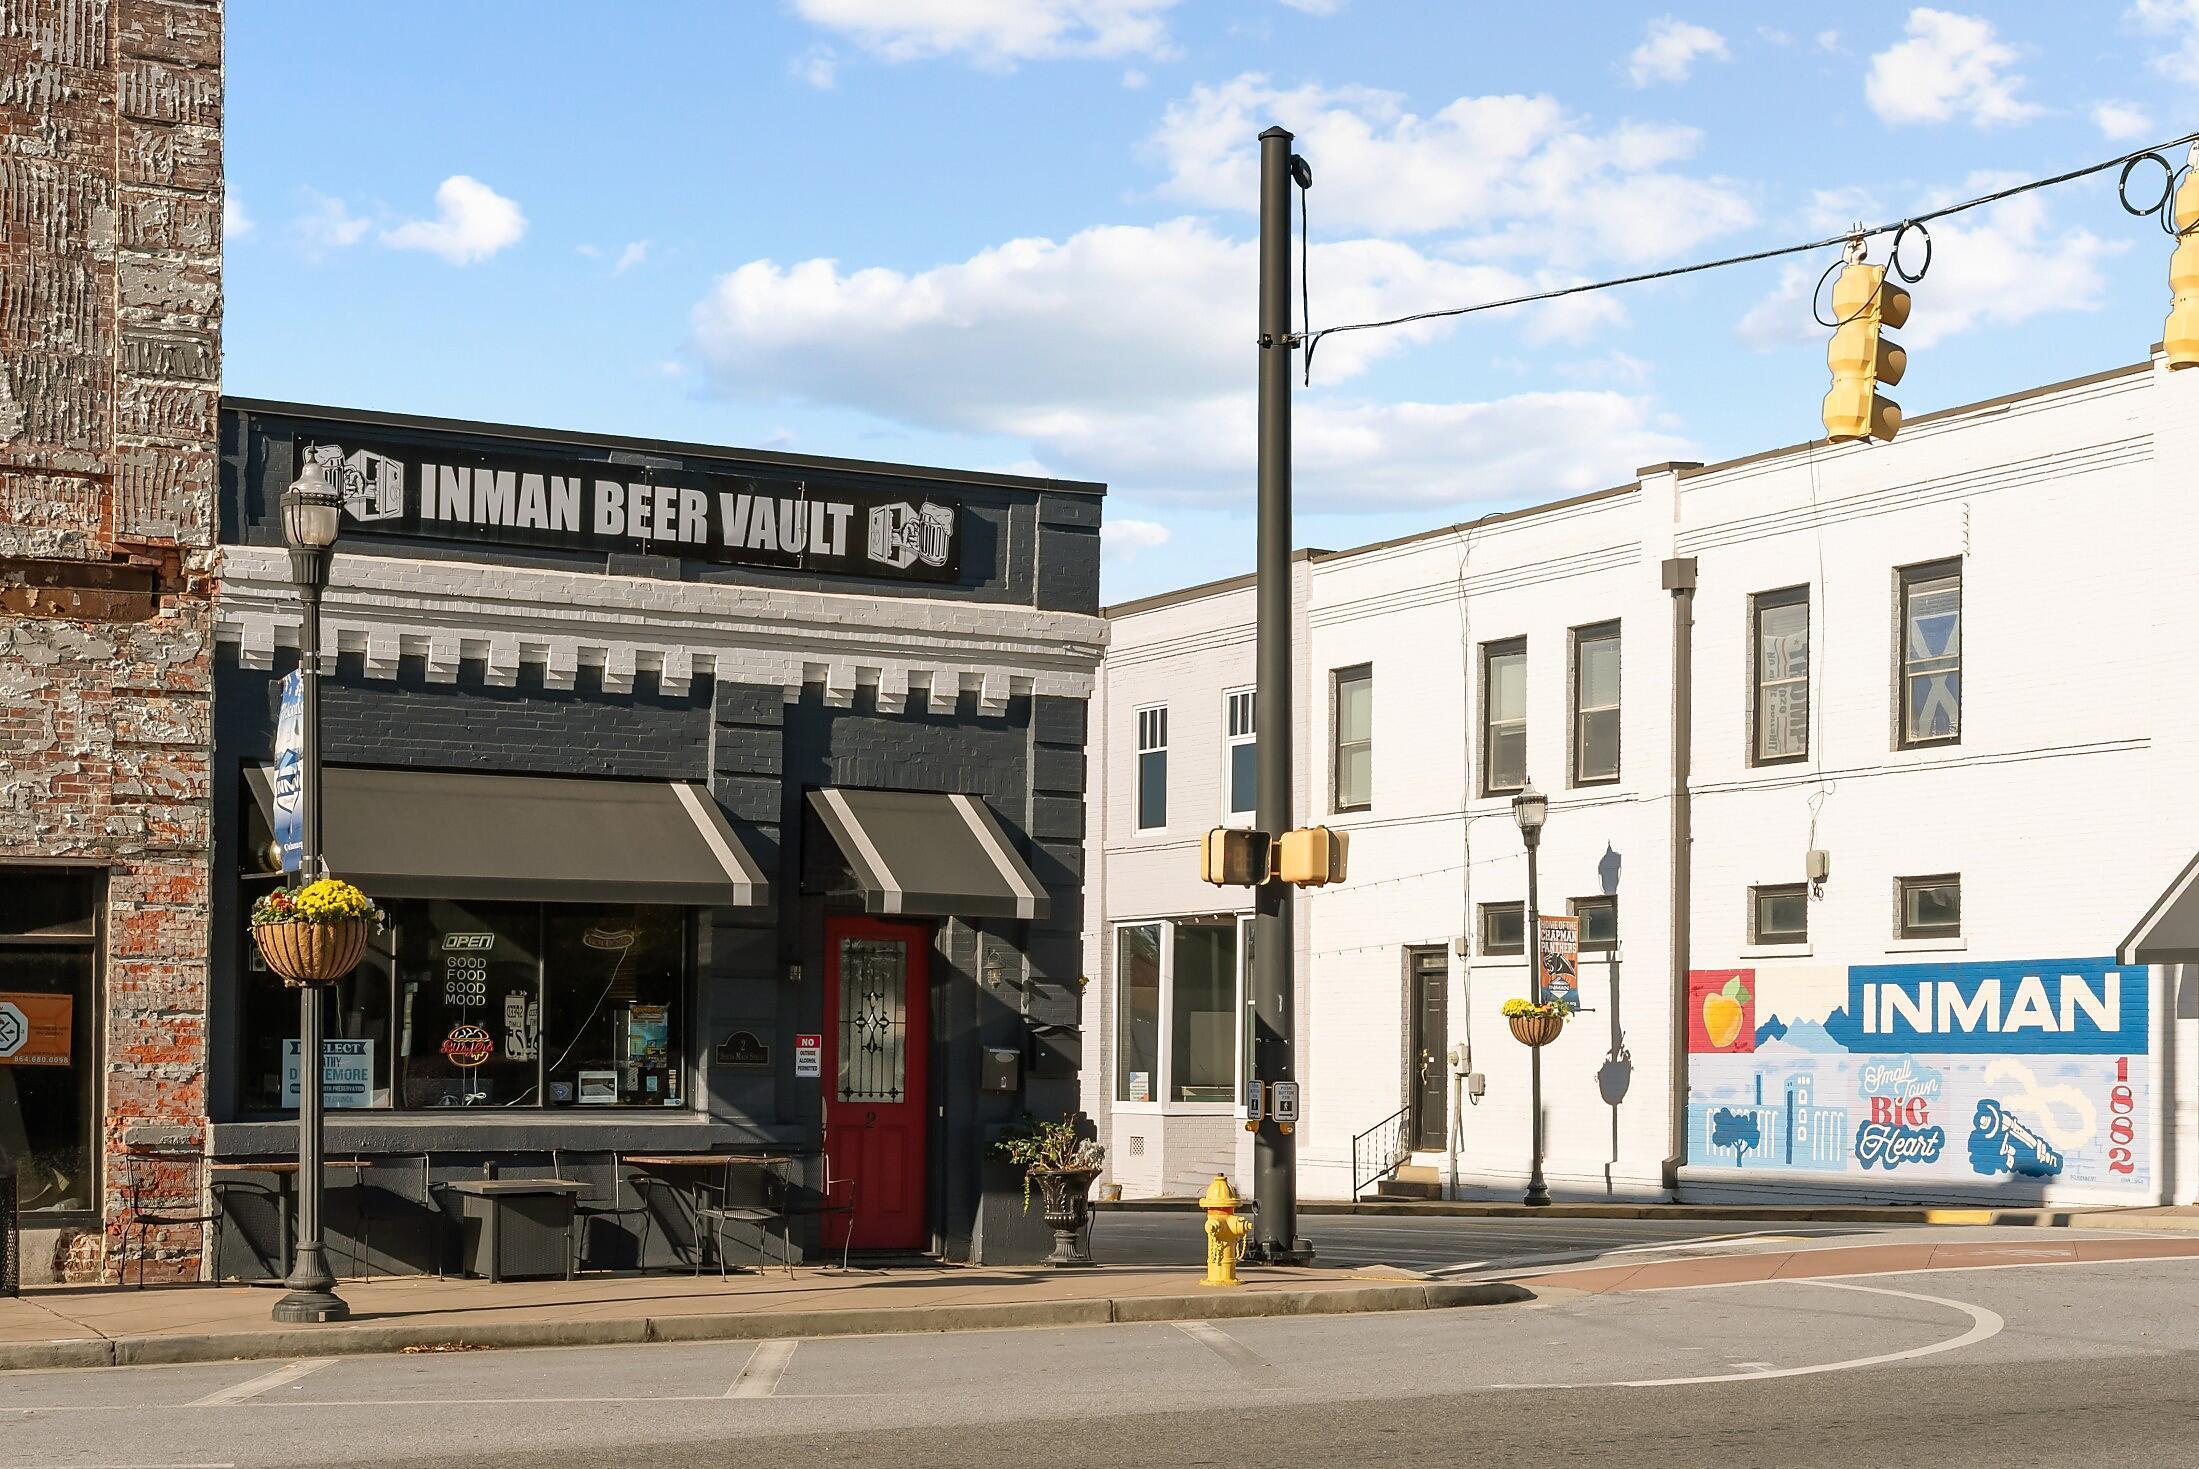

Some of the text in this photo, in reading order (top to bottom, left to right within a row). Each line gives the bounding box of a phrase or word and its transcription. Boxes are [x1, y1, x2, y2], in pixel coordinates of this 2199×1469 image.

[421, 463, 854, 556] INMAN BEER VAULT
[1540, 920, 1577, 930] HOME OF THE
[445, 936, 491, 948] OPEN
[1540, 929, 1577, 942] CHAPMAN
[1540, 941, 1577, 954] PANTHERS
[447, 957, 487, 969] GOOD
[447, 969, 486, 981] FOOD
[446, 982, 486, 994] GOOD
[445, 994, 486, 1006] MOOD
[1863, 972, 2121, 1034] INMAN
[801, 1038, 815, 1047] NO
[323, 1056, 341, 1068] THY
[1864, 1059, 1912, 1093] Small
[1895, 1077, 1939, 1106] Town
[1870, 1096, 1930, 1127] BIG
[2108, 1056, 2135, 1175] 1882
[1860, 1124, 1939, 1164] Heart
